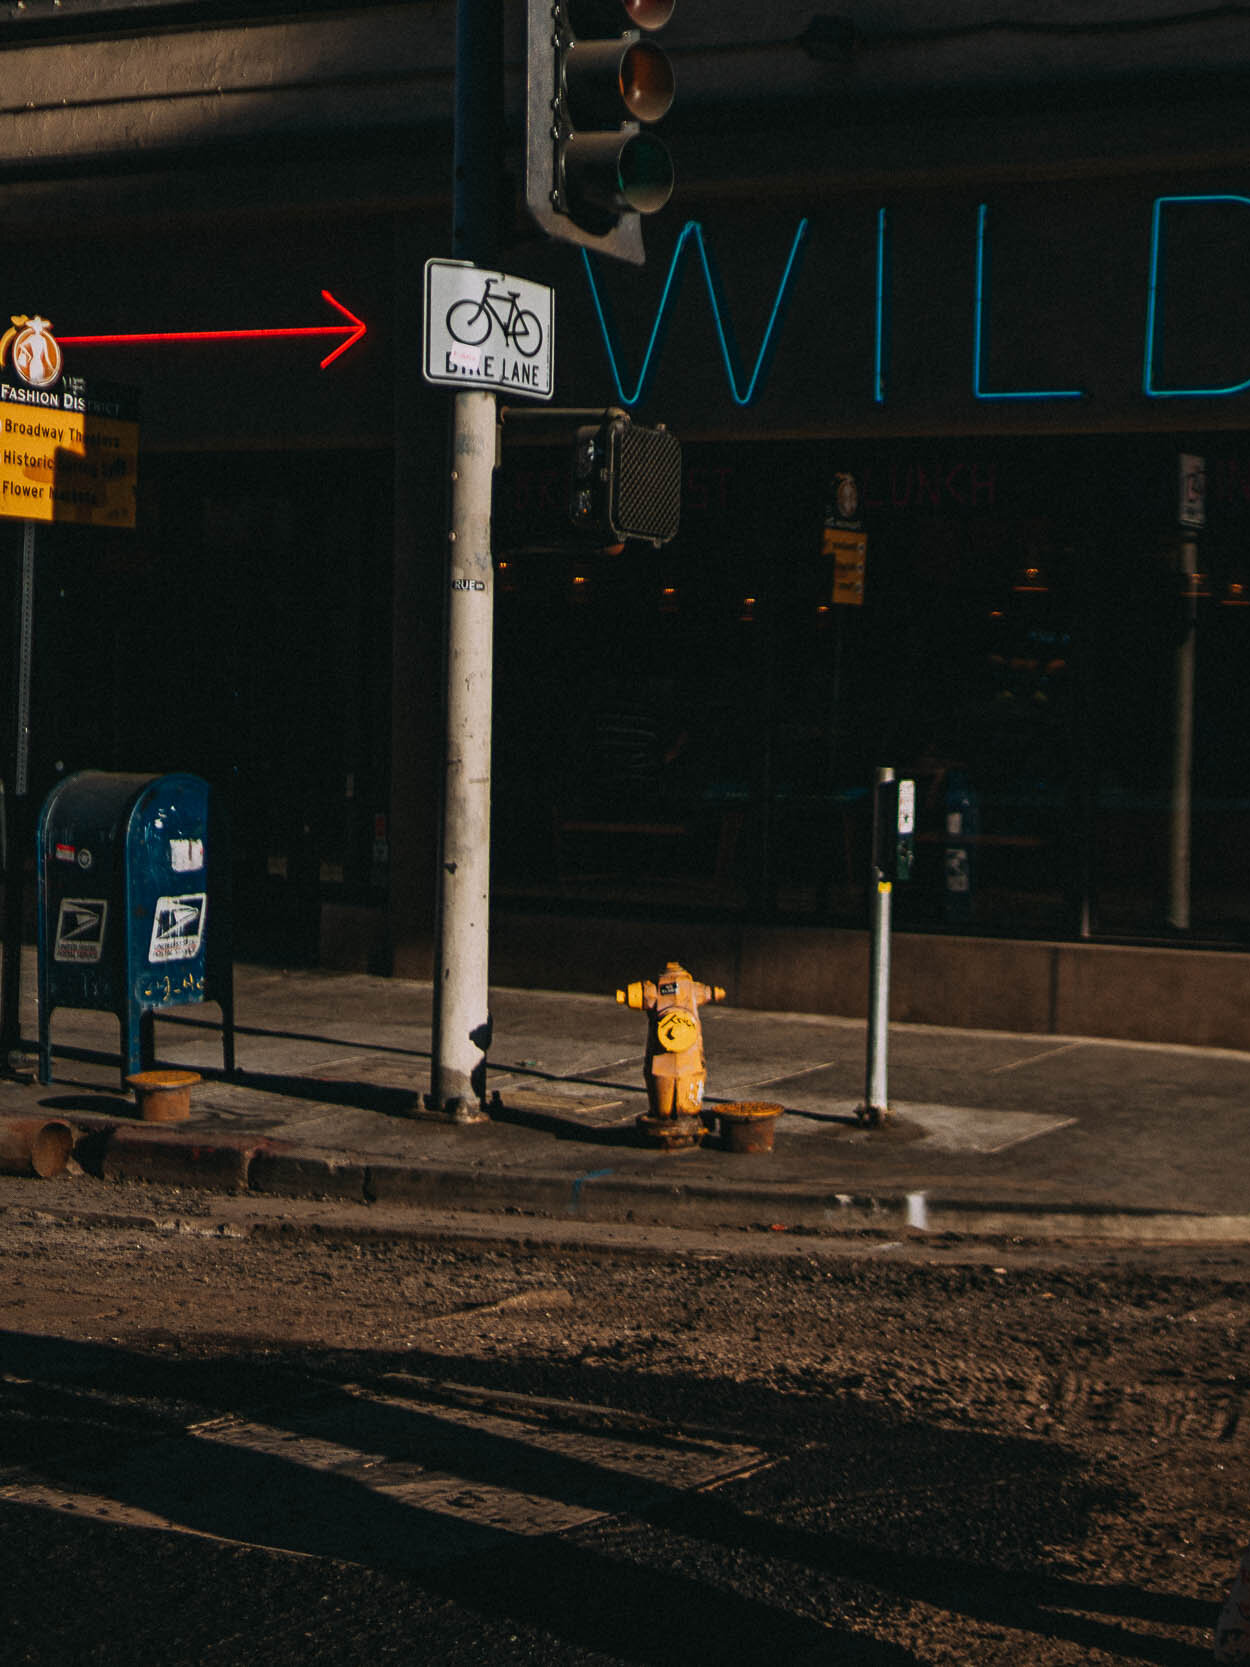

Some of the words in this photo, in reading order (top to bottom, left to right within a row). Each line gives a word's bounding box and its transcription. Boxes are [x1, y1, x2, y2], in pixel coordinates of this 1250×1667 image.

[445, 351, 494, 377] BE
[502, 359, 539, 386] LANE
[1, 383, 59, 407] FASHION
[5, 418, 64, 442] Broadway
[3, 449, 55, 470] Historic
[2, 480, 44, 498] Flower
